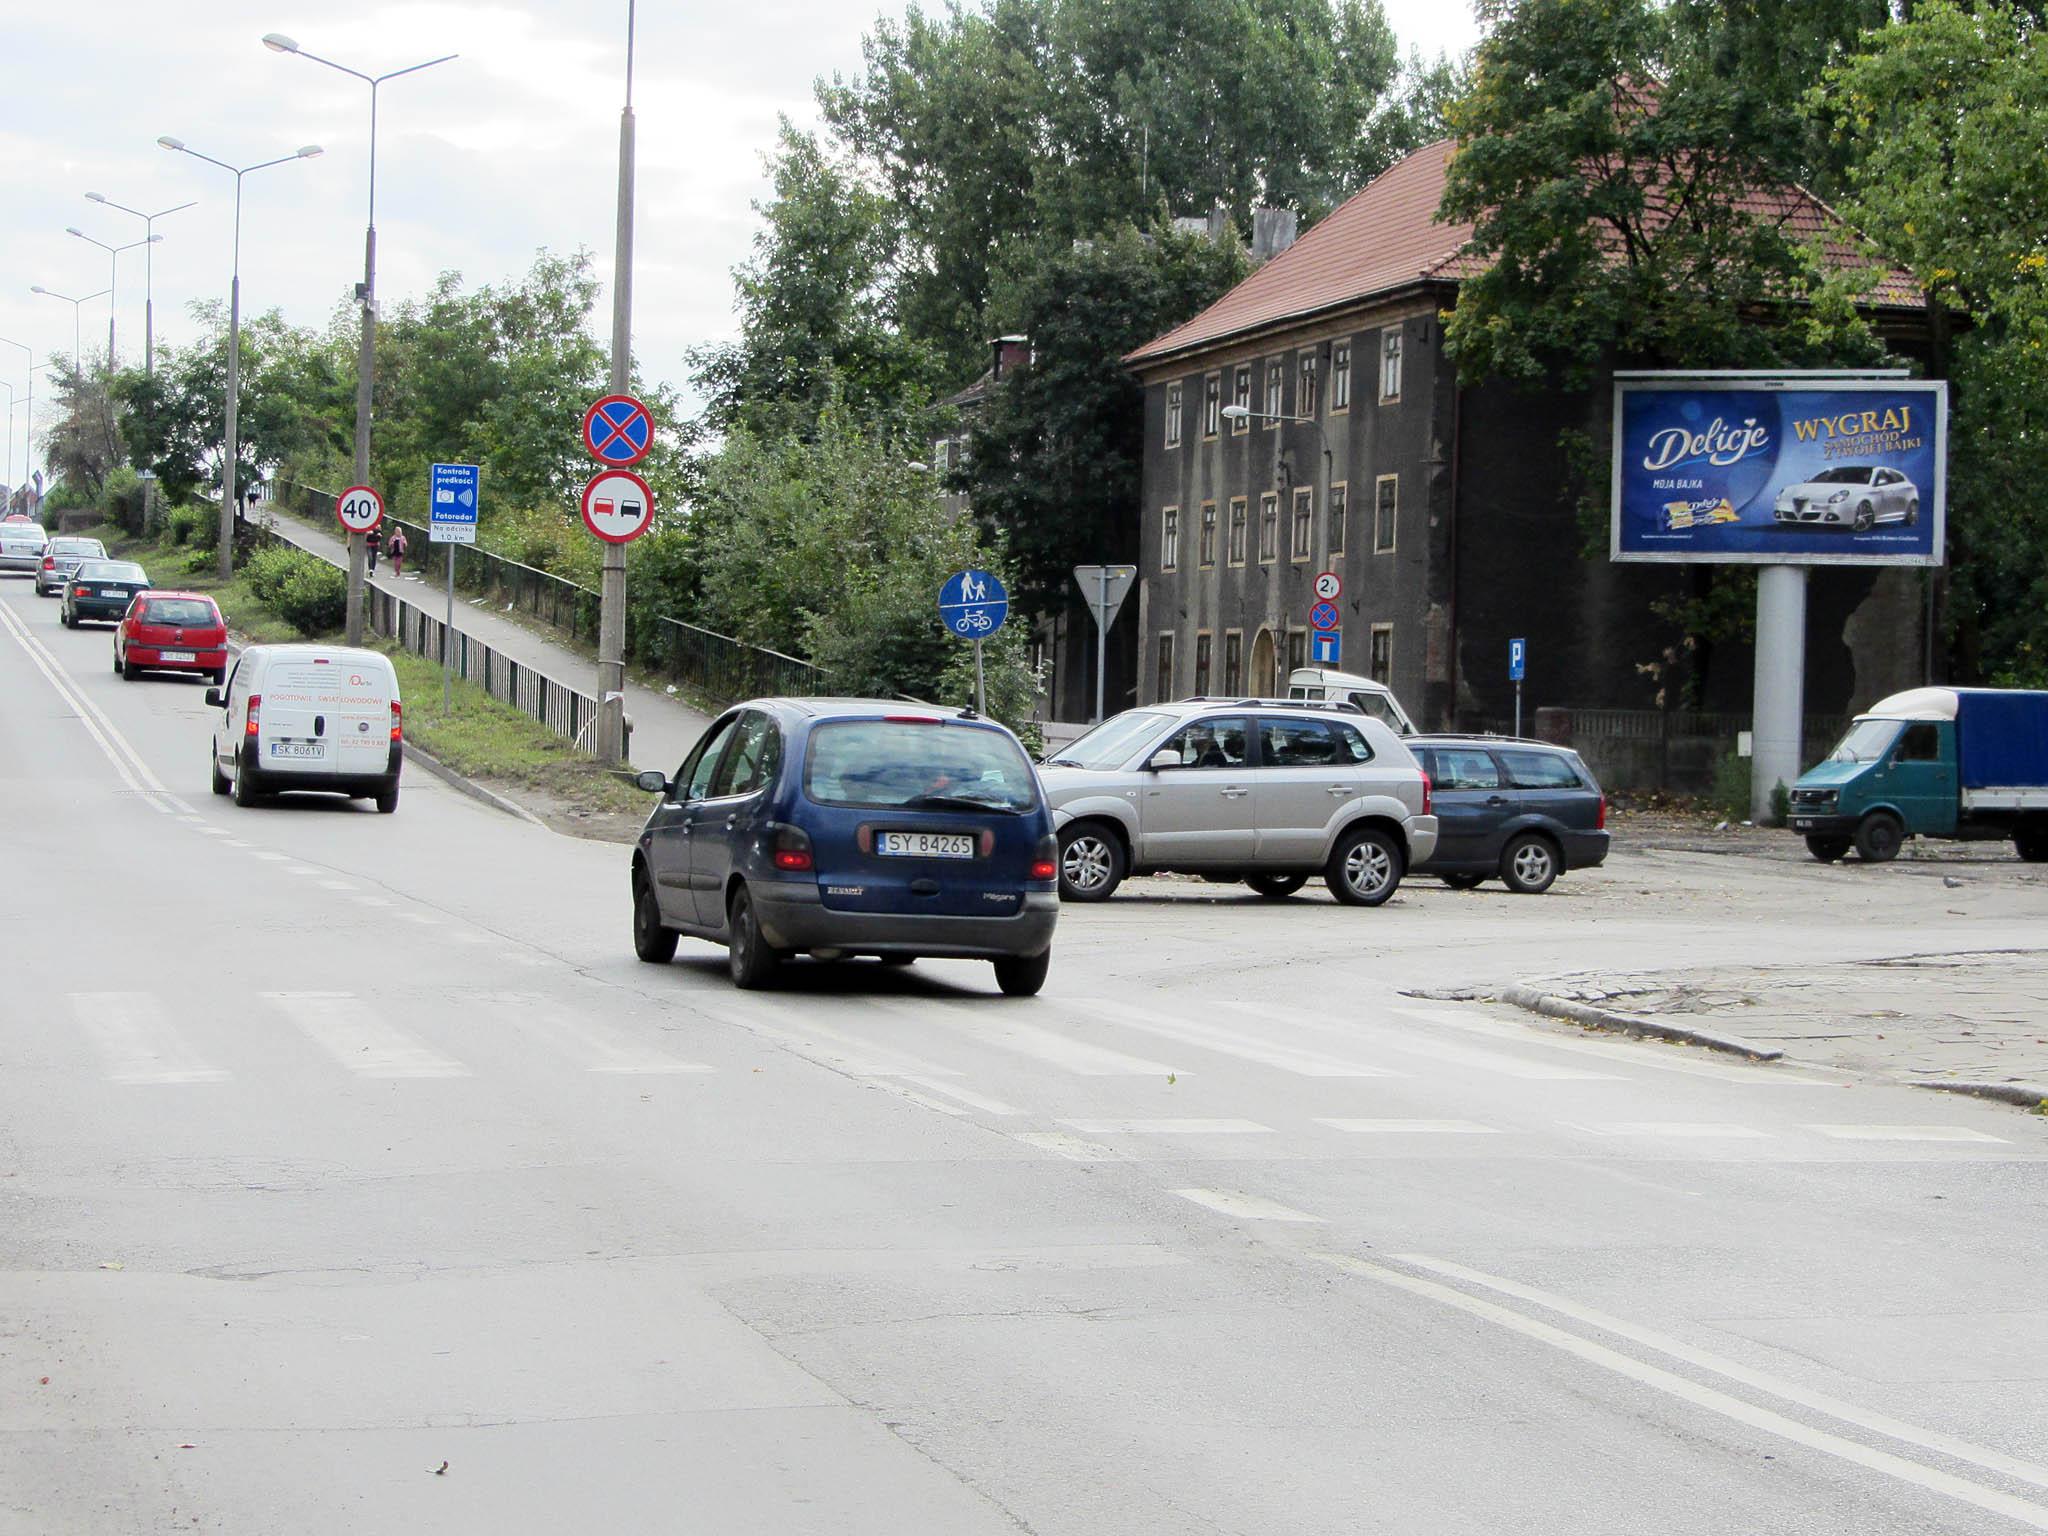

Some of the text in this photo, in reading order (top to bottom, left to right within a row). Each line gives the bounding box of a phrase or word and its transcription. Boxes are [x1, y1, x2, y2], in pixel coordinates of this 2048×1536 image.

[1793, 406, 1910, 442] WYGRAJ
[1643, 417, 1769, 470] Delicje
[1886, 437, 1921, 452] BAJKI
[437, 467, 470, 475] Kontrola
[1653, 479, 1703, 489] MOJA BAJKA
[435, 511, 473, 521] Fotoradar
[278, 745, 323, 756] SK 8061V
[888, 834, 971, 854] SY 84265
